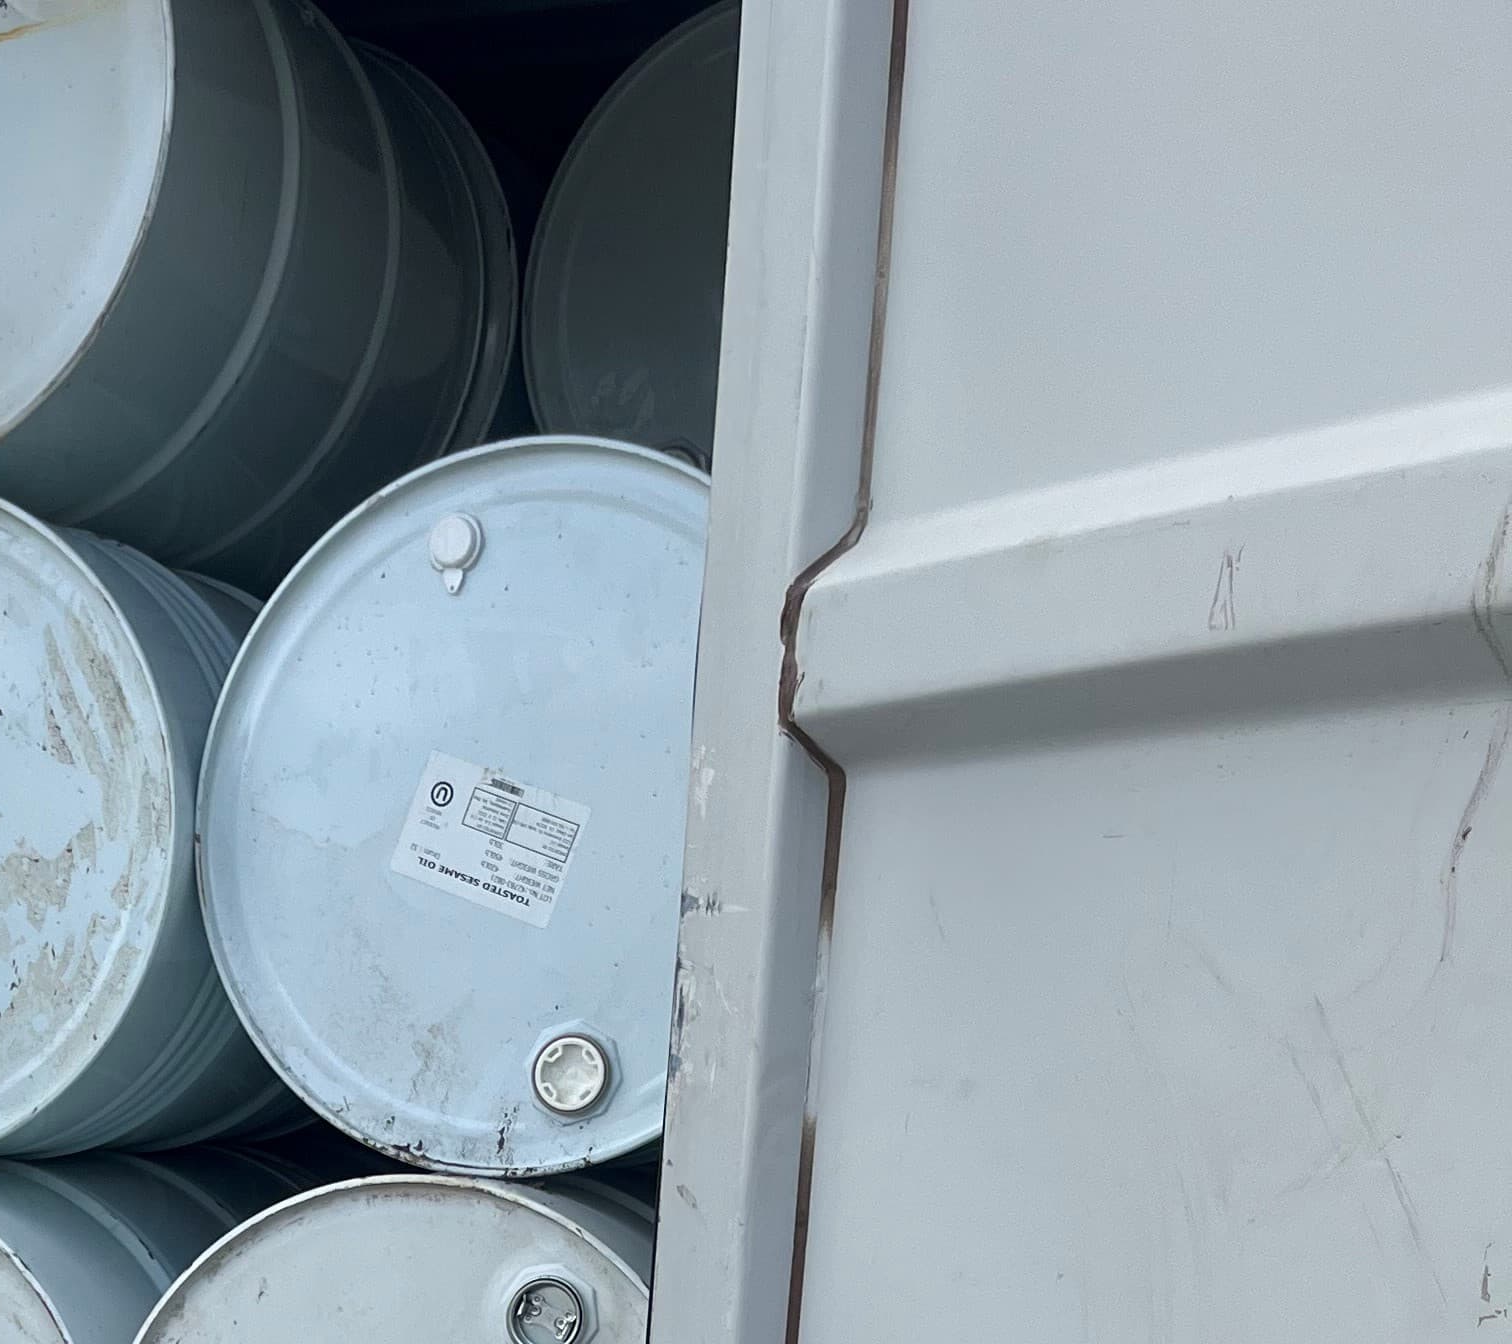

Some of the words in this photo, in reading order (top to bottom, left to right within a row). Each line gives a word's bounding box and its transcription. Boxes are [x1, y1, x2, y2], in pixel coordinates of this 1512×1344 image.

[415, 856, 436, 870] OIL
[437, 865, 480, 886] SESAME
[480, 881, 531, 907] TOASTED
